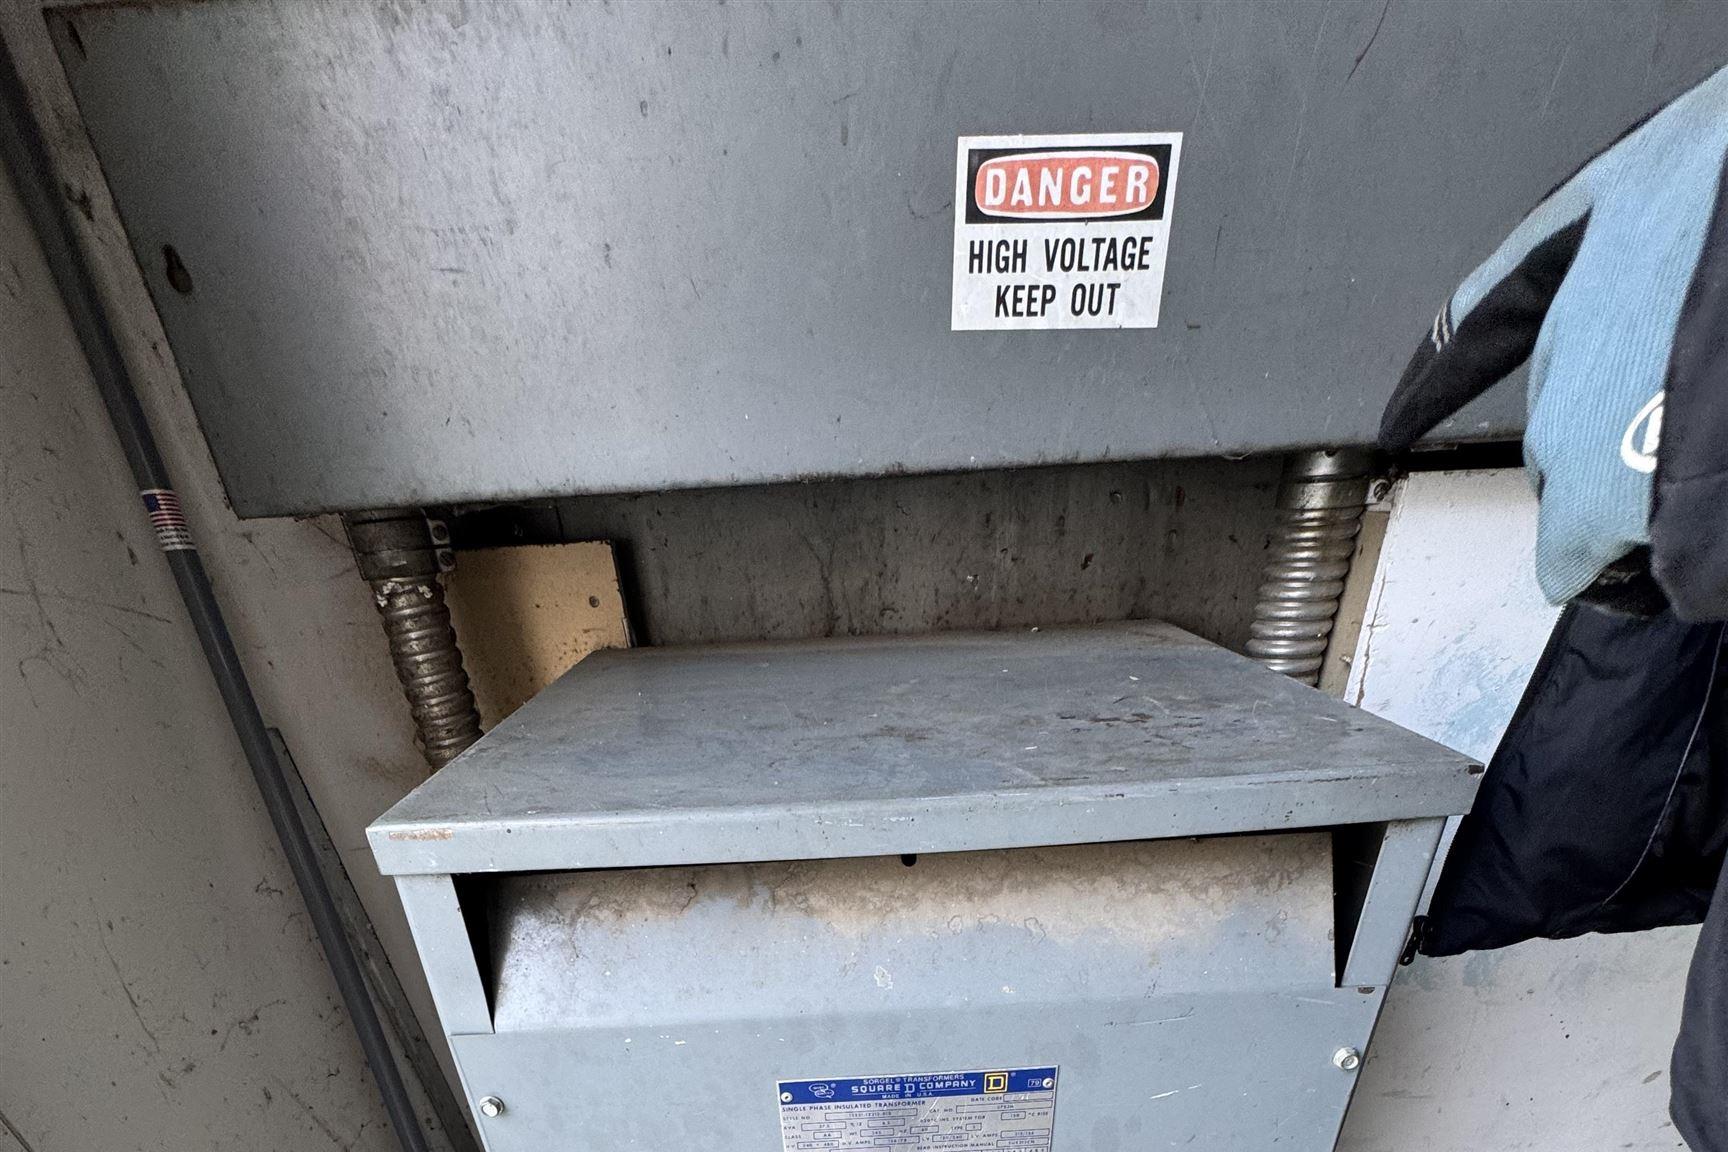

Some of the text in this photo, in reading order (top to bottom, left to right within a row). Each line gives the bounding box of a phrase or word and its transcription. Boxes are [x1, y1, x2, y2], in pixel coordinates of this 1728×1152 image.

[984, 165, 1149, 207] DANGER
[968, 236, 1154, 274] HIGH VOLTAGE
[994, 282, 1122, 318] KEEP OUT
[851, 1079, 976, 1094] SQUARE D COMPANY
[902, 1074, 965, 1083] TRANSFORMERS
